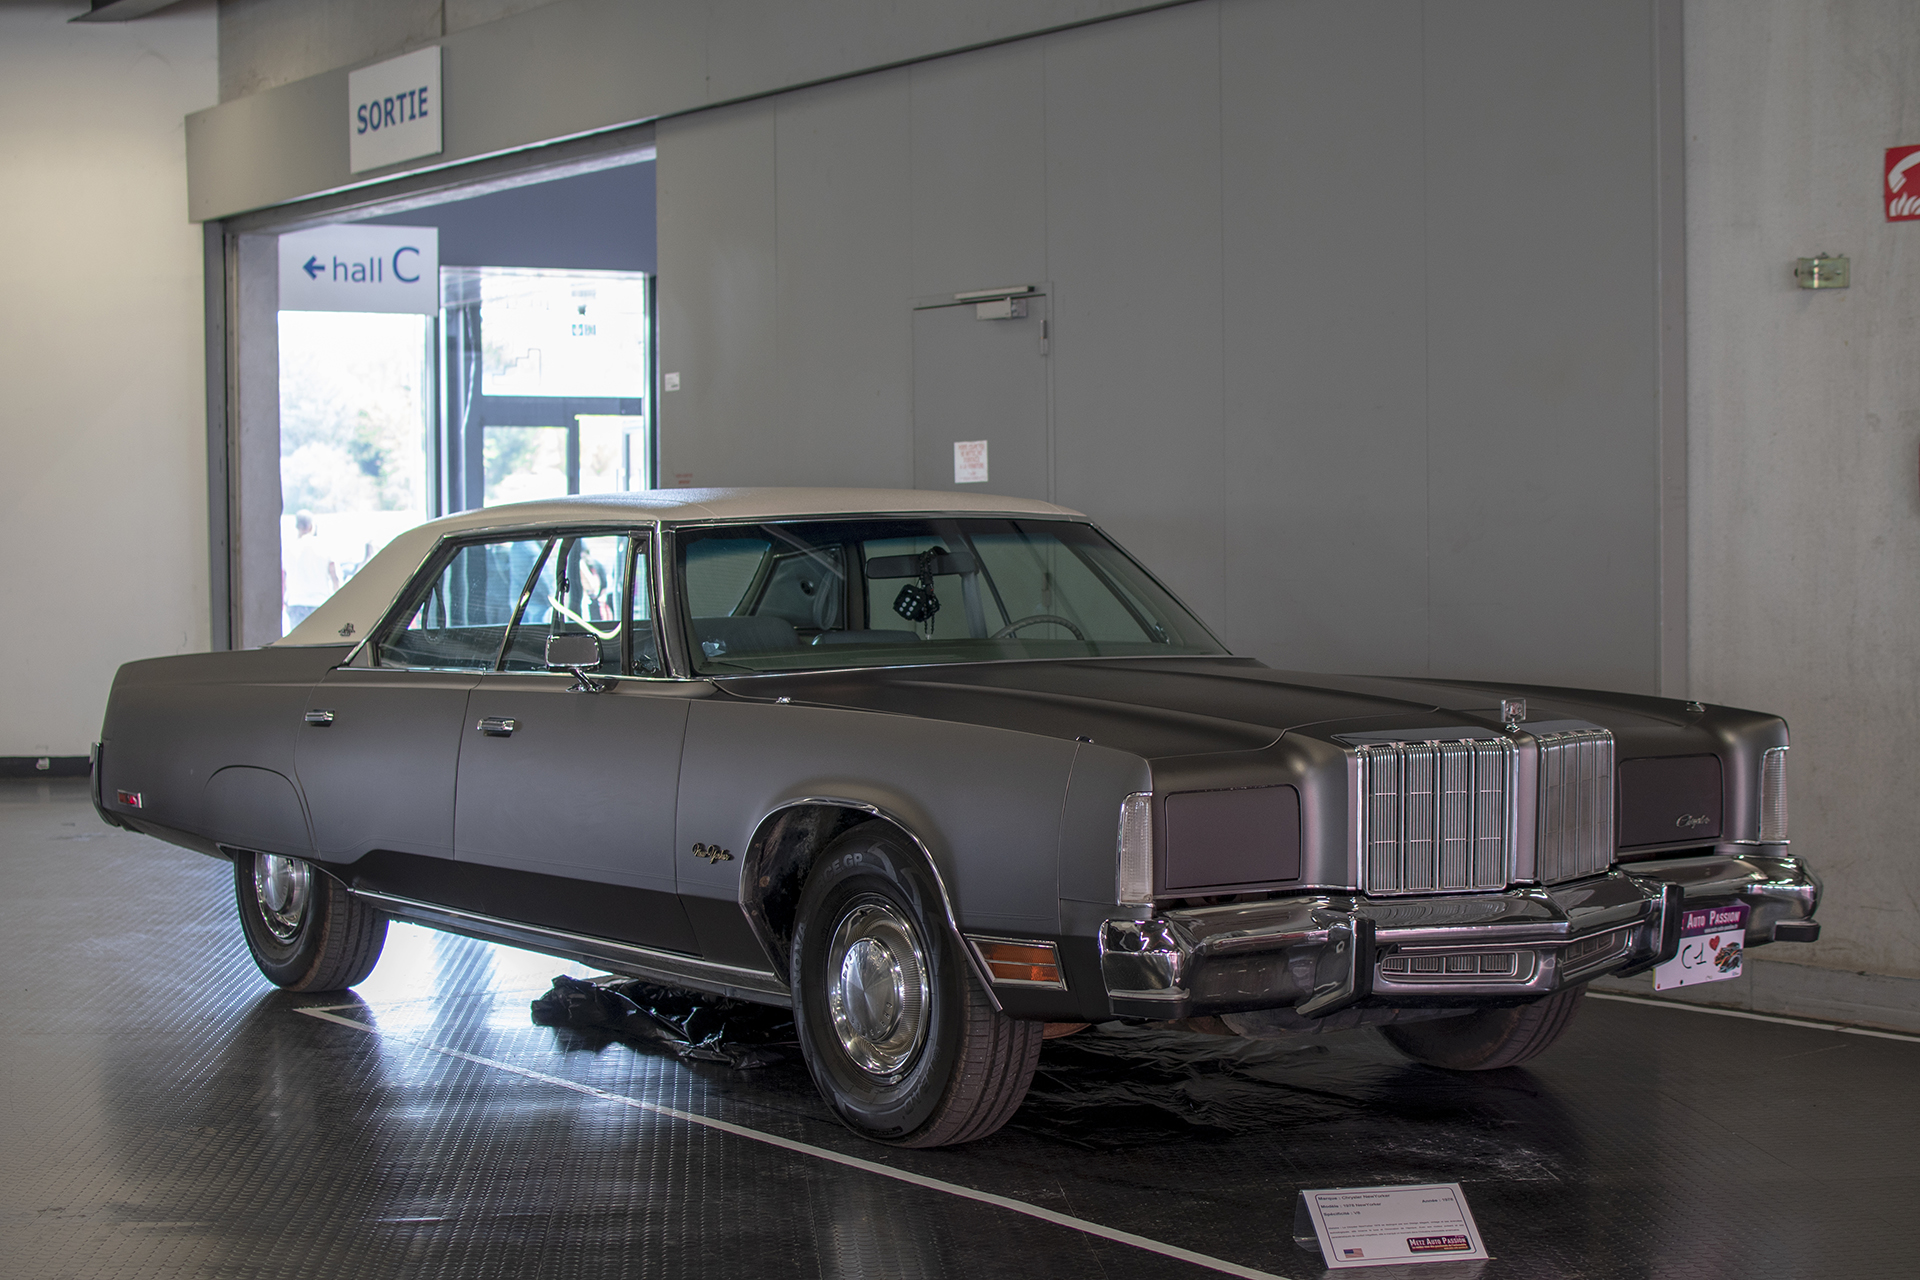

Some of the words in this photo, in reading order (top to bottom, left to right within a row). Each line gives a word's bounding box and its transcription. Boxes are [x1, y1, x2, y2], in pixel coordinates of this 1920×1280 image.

[357, 86, 428, 135] SORTIE
[333, 255, 382, 283] hall
[392, 246, 420, 283] C
